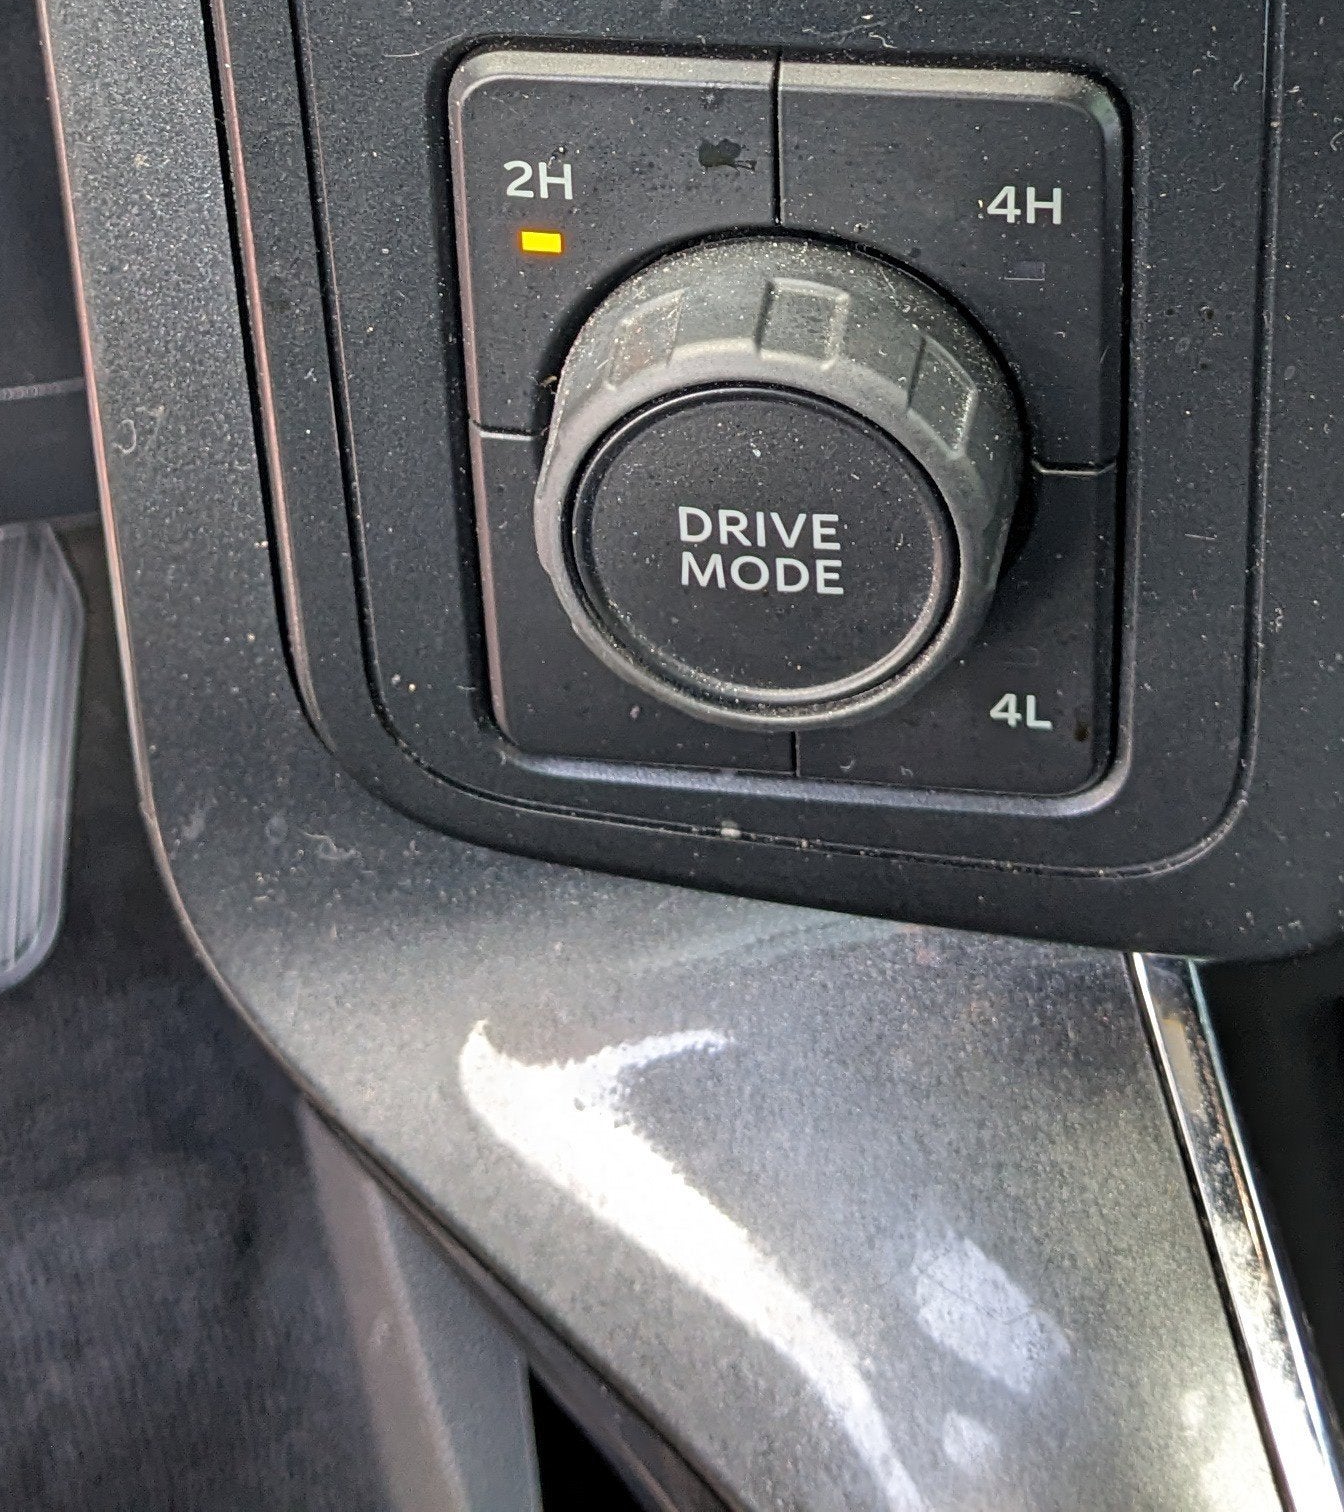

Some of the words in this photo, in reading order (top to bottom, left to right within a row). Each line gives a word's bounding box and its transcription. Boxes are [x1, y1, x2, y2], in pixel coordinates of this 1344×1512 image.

[503, 160, 573, 200] 2H
[986, 185, 1062, 225] 4H
[678, 505, 841, 551] DRIVE
[681, 551, 844, 595] MODE
[989, 693, 1053, 730] 4L
